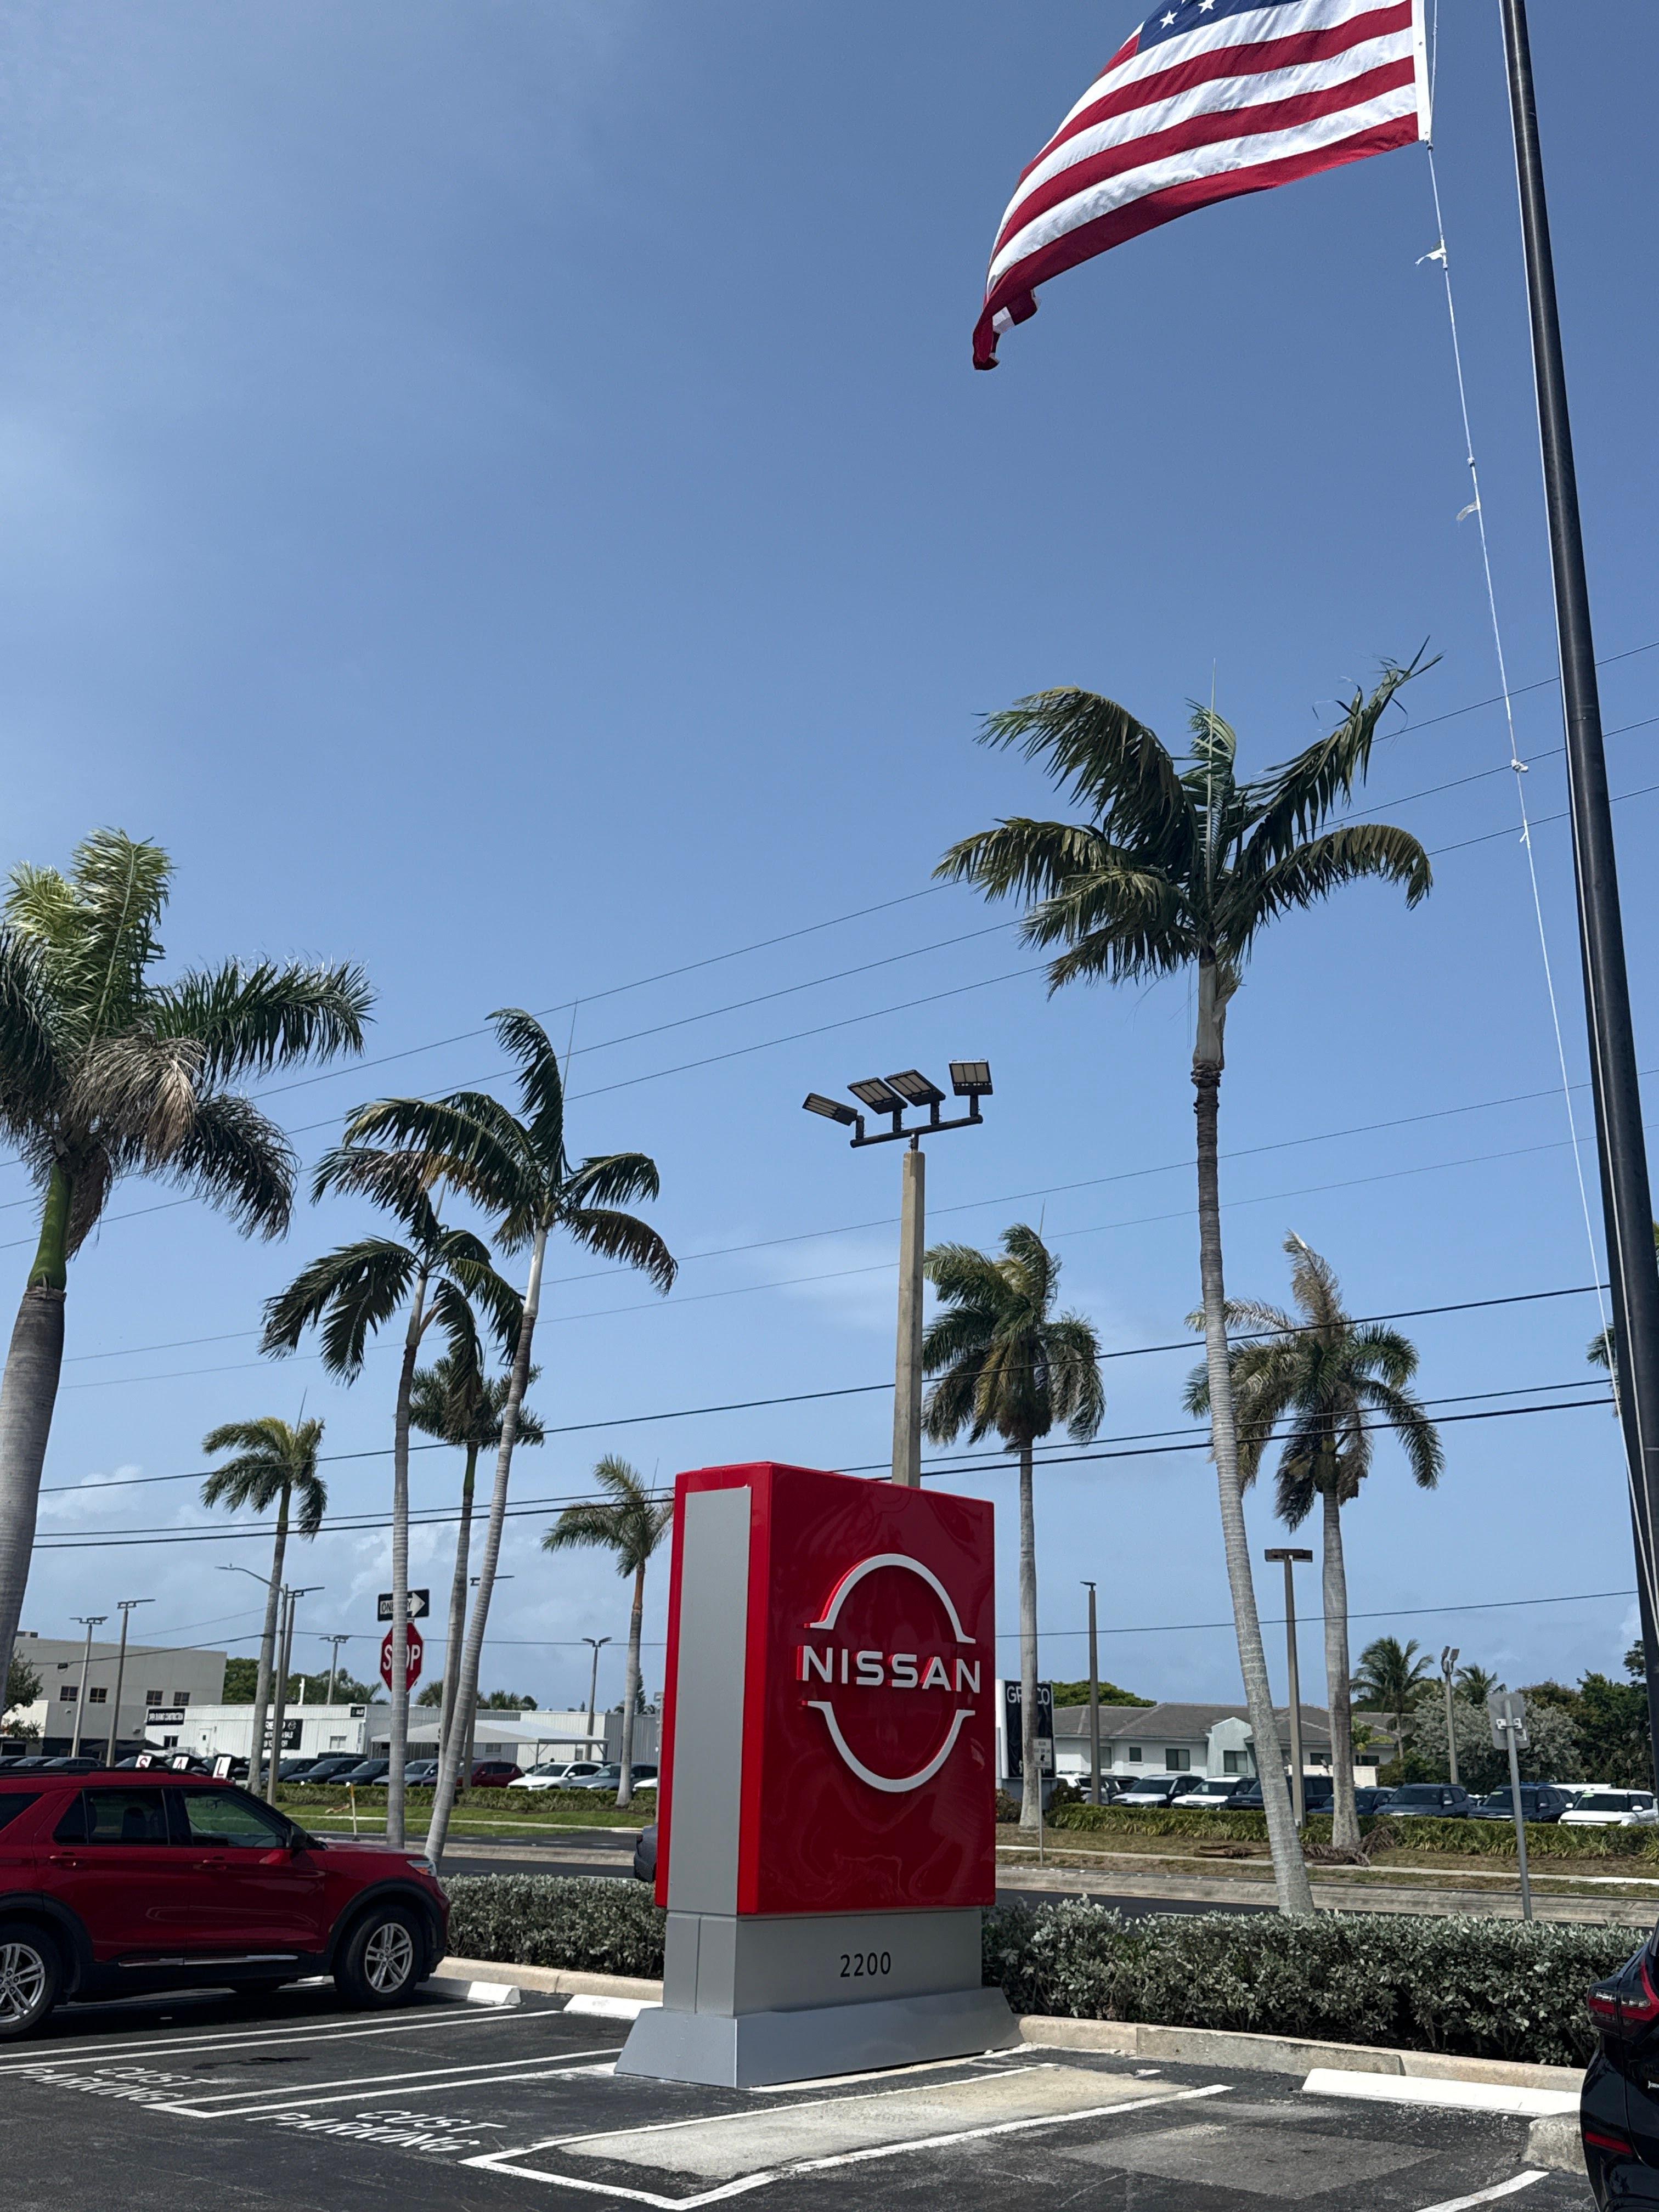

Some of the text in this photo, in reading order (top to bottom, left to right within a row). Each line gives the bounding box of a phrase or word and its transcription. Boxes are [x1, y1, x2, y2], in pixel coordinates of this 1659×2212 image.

[801, 1645, 980, 1694] NISSAN
[840, 1951, 891, 1978] 2200
[0, 2068, 184, 2102] PARKING
[94, 2067, 228, 2087] CUST
[245, 2113, 481, 2152] PARKING
[356, 2110, 507, 2133] CUST
